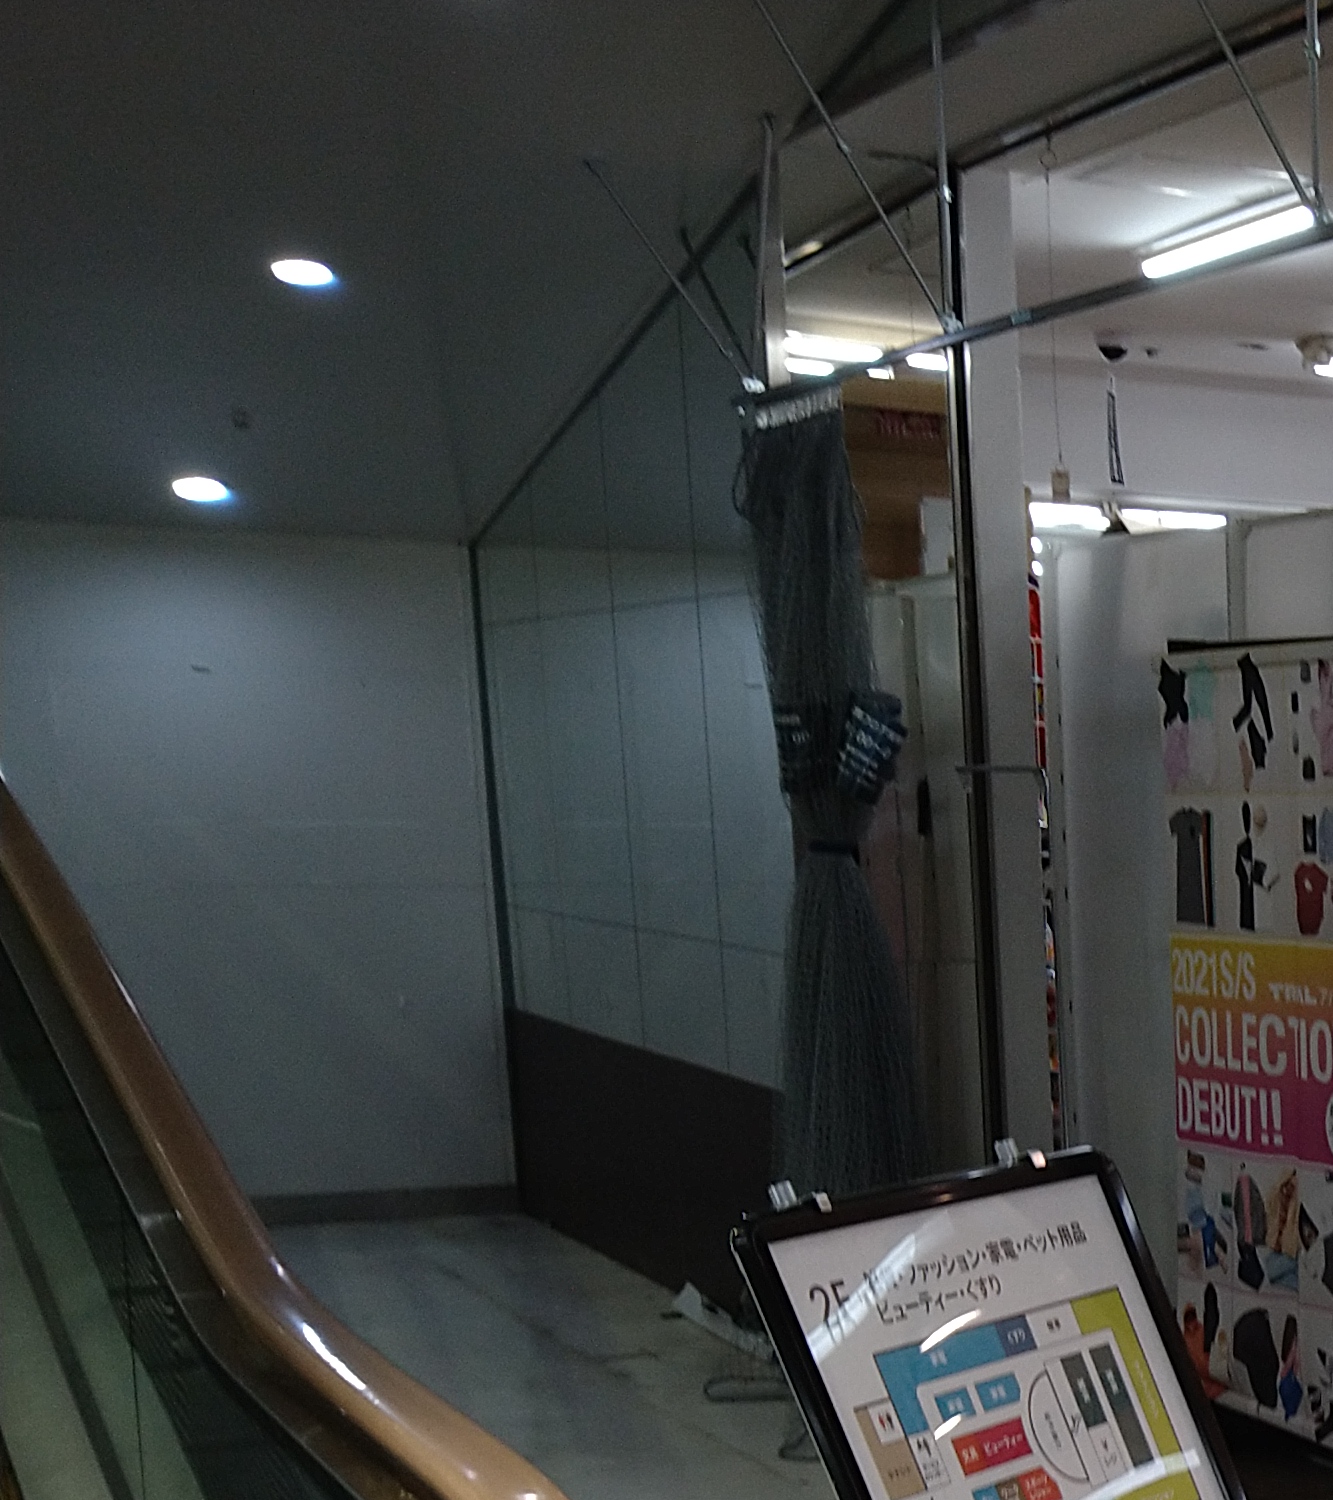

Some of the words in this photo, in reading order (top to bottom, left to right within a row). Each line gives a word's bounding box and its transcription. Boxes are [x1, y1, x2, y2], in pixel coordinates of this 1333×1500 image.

[1176, 1075, 1284, 1146] DEBUT!!
[875, 1273, 1003, 1325] ビューティー・くすり
